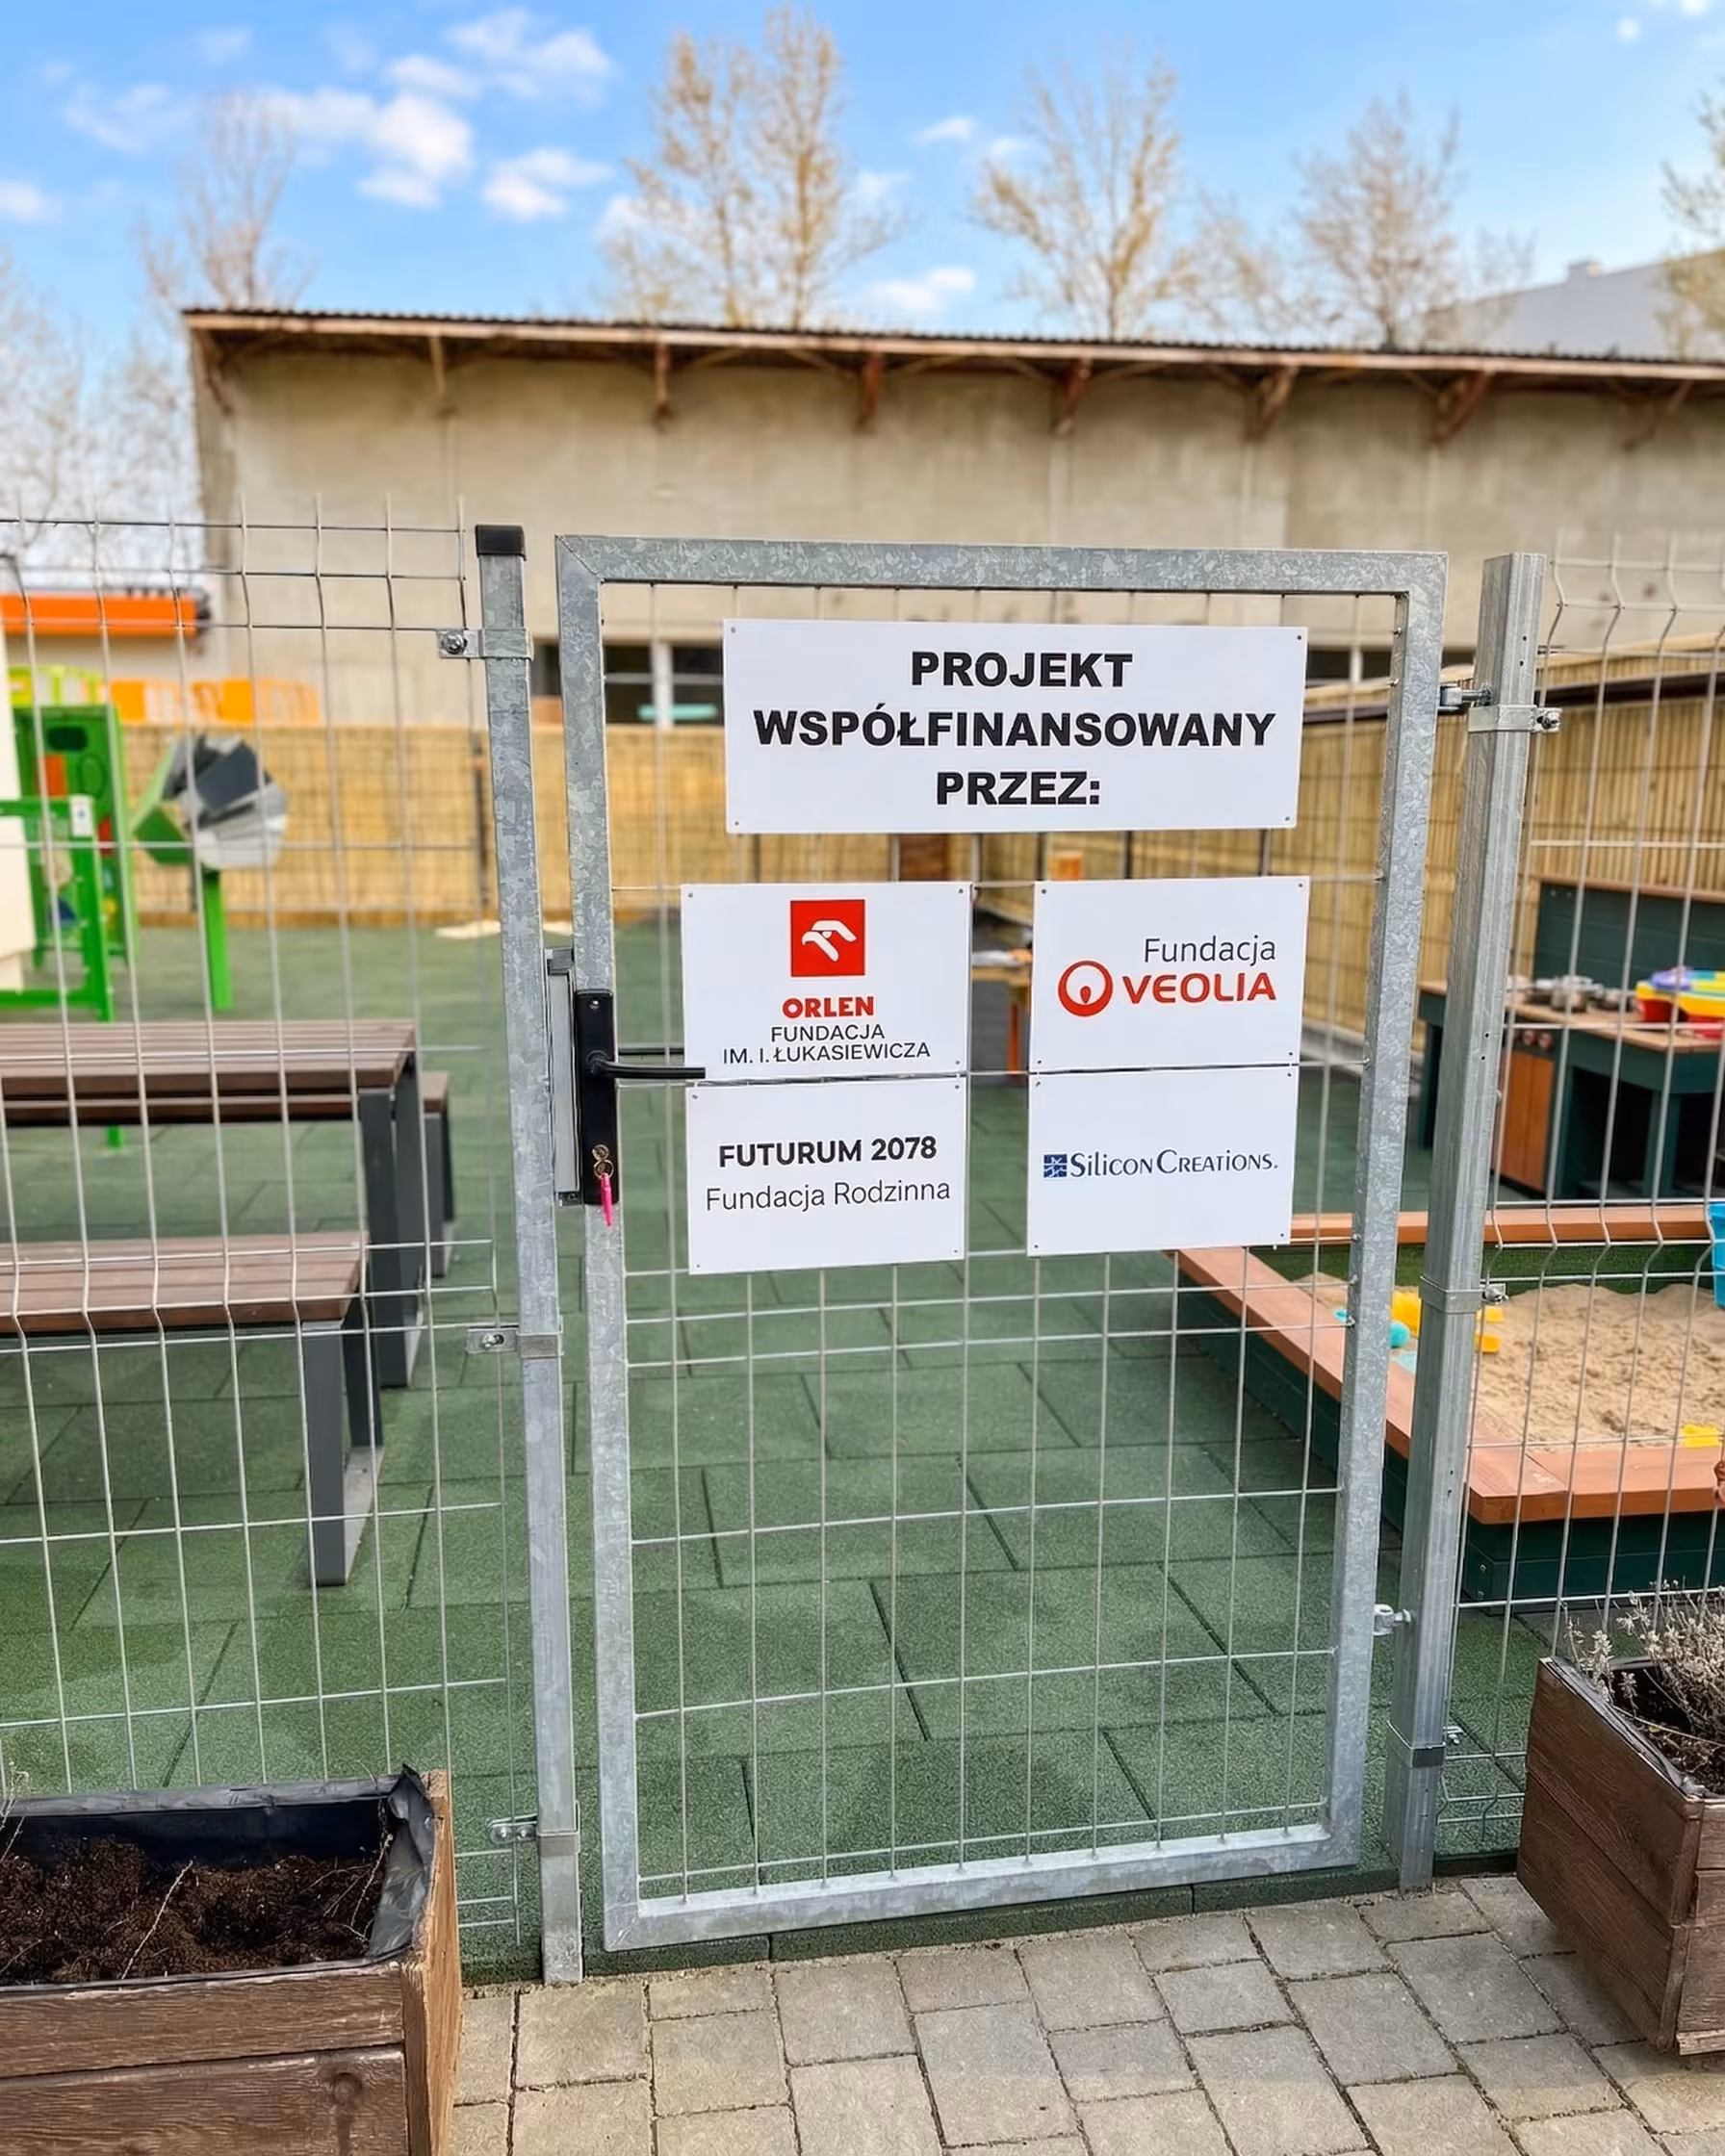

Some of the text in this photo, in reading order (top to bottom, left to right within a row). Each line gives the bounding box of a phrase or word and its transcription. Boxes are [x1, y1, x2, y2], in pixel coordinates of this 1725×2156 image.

[912, 651, 1133, 688] PROJEKT
[753, 702, 1276, 747] WSPÓŁFINANSOWANY
[937, 770, 1100, 806] PRZEZ:
[1145, 935, 1276, 967] Fundacja
[1121, 972, 1276, 1005] VEOLIA
[782, 995, 875, 1019] ORLEN
[771, 1023, 886, 1042] FUNDACJA
[723, 1047, 754, 1065] IM.
[719, 1135, 938, 1168] FUTURUM 2078
[706, 1179, 950, 1213] Fundacja Rodzinna
